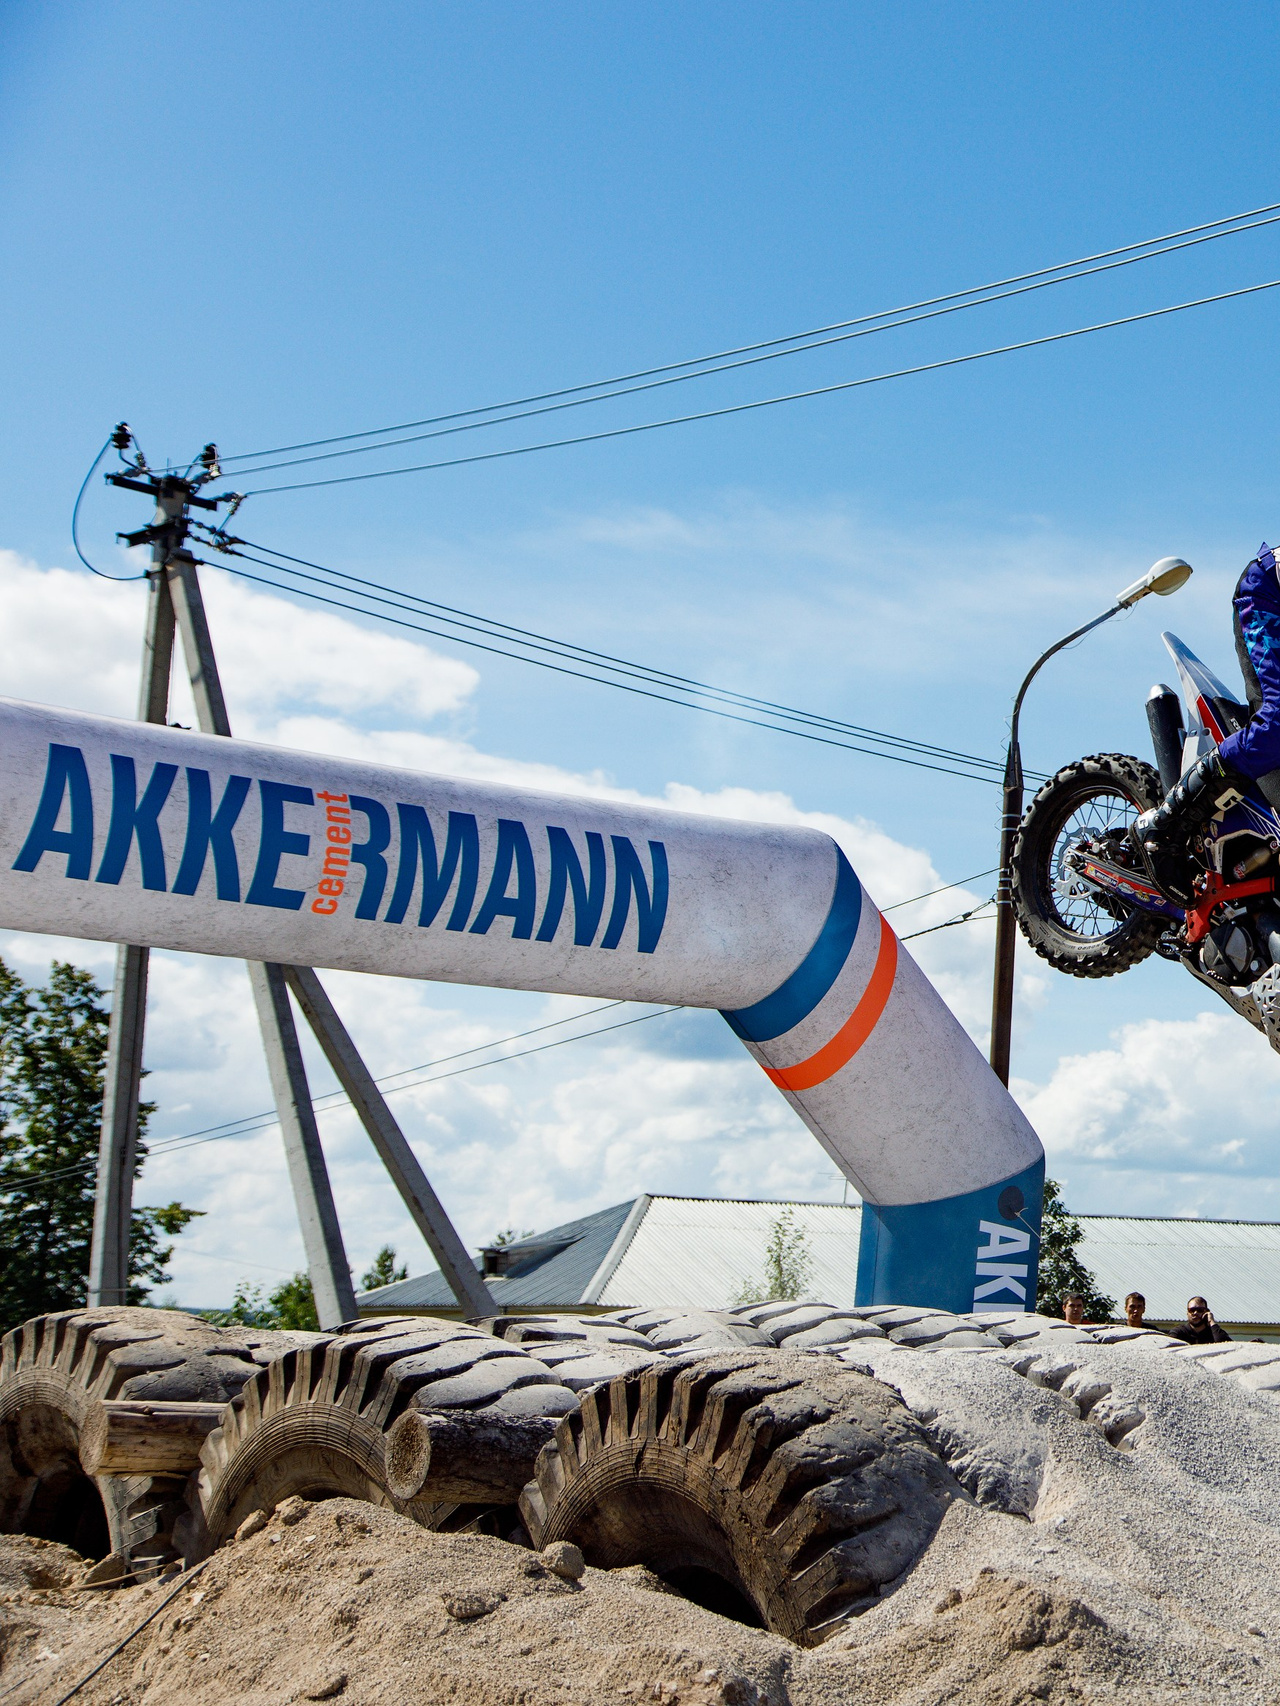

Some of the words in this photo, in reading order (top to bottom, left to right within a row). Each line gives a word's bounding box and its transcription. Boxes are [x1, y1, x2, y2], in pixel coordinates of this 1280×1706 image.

[12, 742, 669, 954] AKKERMANN
[311, 790, 351, 915] cement
[973, 1219, 1030, 1314] AK
